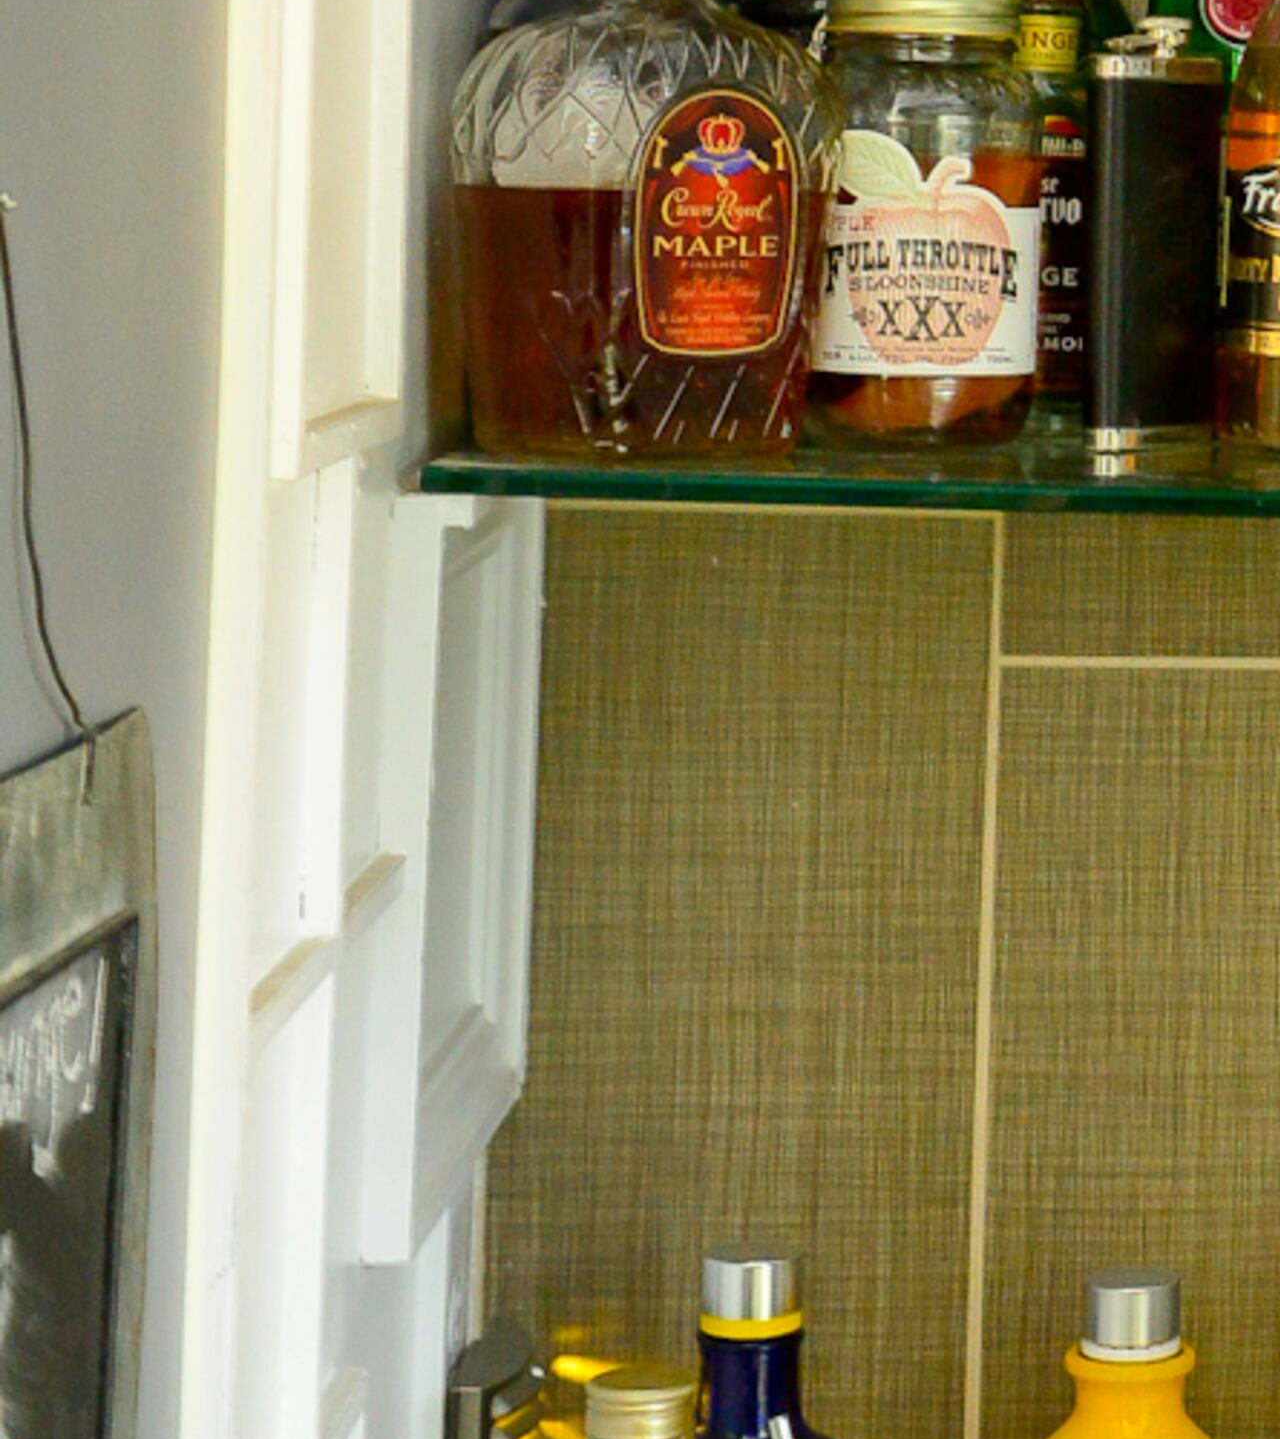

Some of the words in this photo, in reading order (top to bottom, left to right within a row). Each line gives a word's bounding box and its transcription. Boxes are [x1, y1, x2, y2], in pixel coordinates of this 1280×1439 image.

[661, 187, 714, 228] Crown
[697, 189, 773, 232] Royal
[652, 234, 780, 258] MAPLE
[824, 240, 891, 295] FULL
[897, 238, 1018, 298] THROTTLE
[876, 294, 967, 342] XXX
